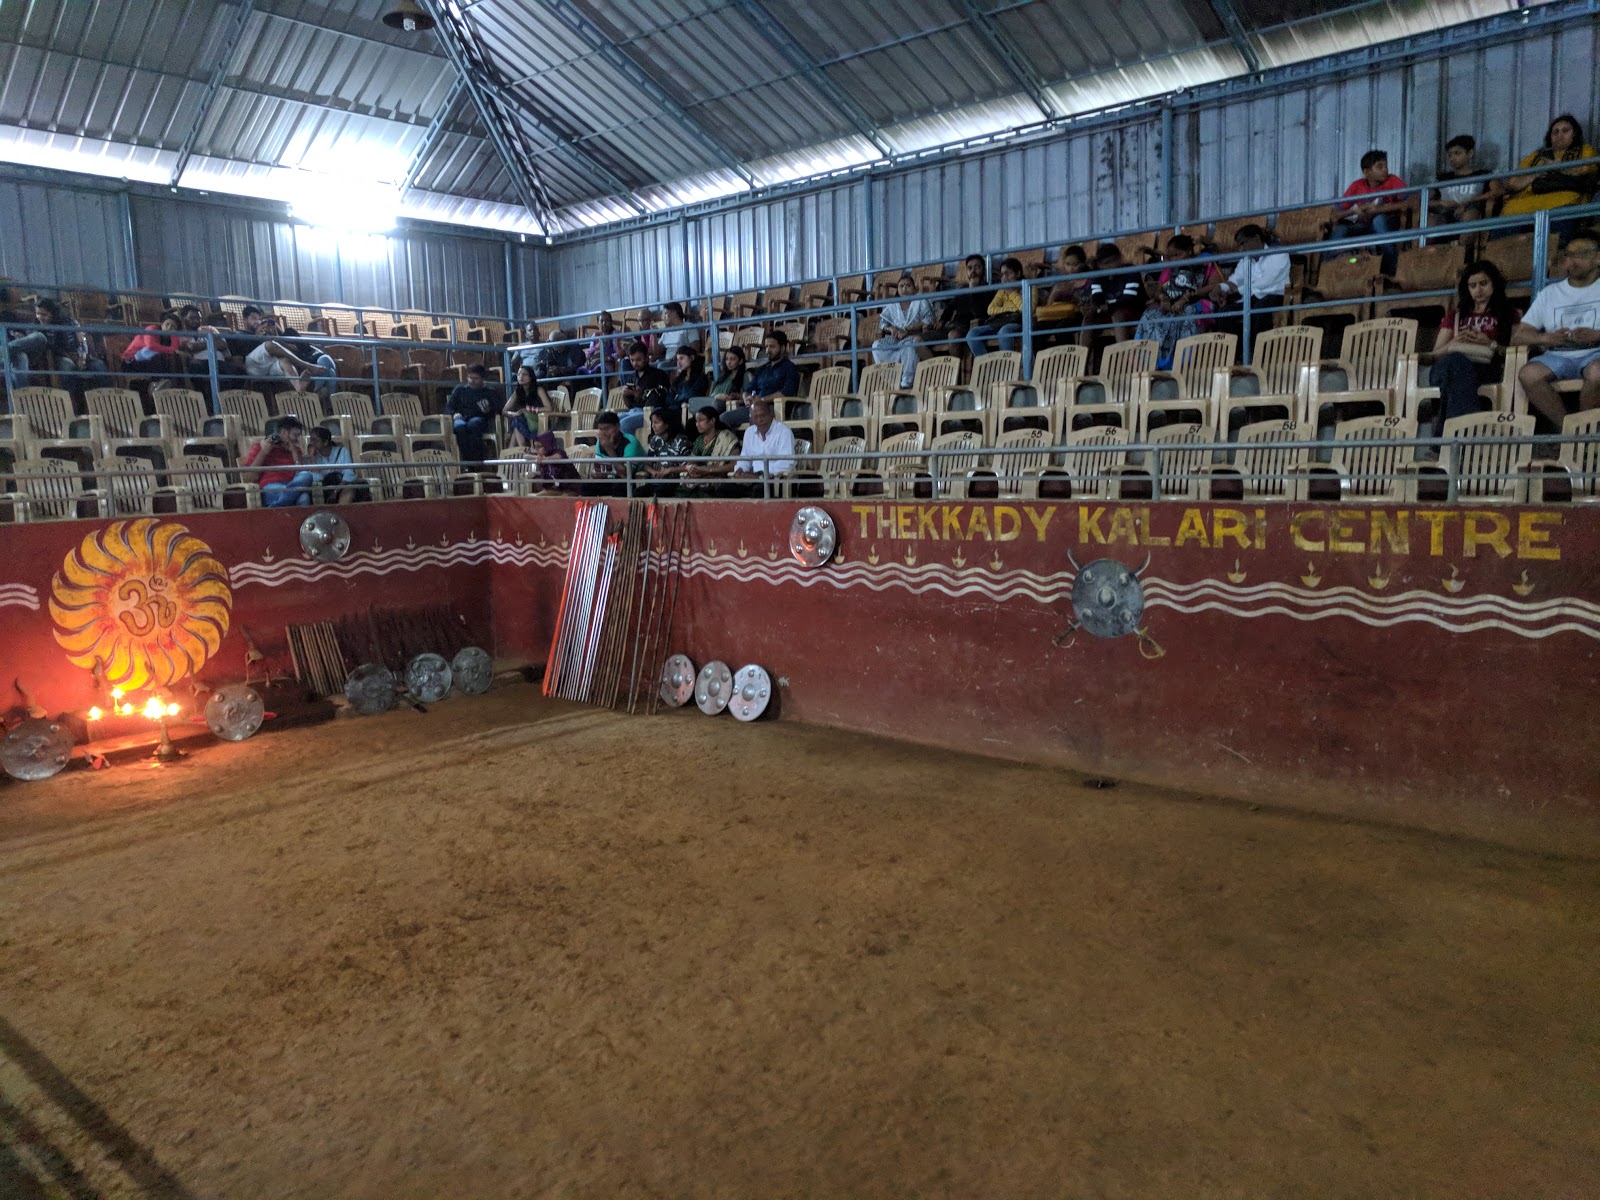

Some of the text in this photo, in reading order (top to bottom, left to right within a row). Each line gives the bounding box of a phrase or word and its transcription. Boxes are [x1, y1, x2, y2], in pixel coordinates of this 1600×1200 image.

[1387, 318, 1403, 327] 140
[1384, 417, 1400, 427] 59
[1497, 412, 1516, 423] 60
[1188, 424, 1202, 434] 57
[1282, 420, 1297, 431] 58
[962, 432, 973, 440] 54
[1030, 429, 1043, 438] 55
[1105, 427, 1117, 436] 56
[197, 455, 209, 463] 40
[851, 504, 1563, 561] THEKKADY KALARI CENTRE
